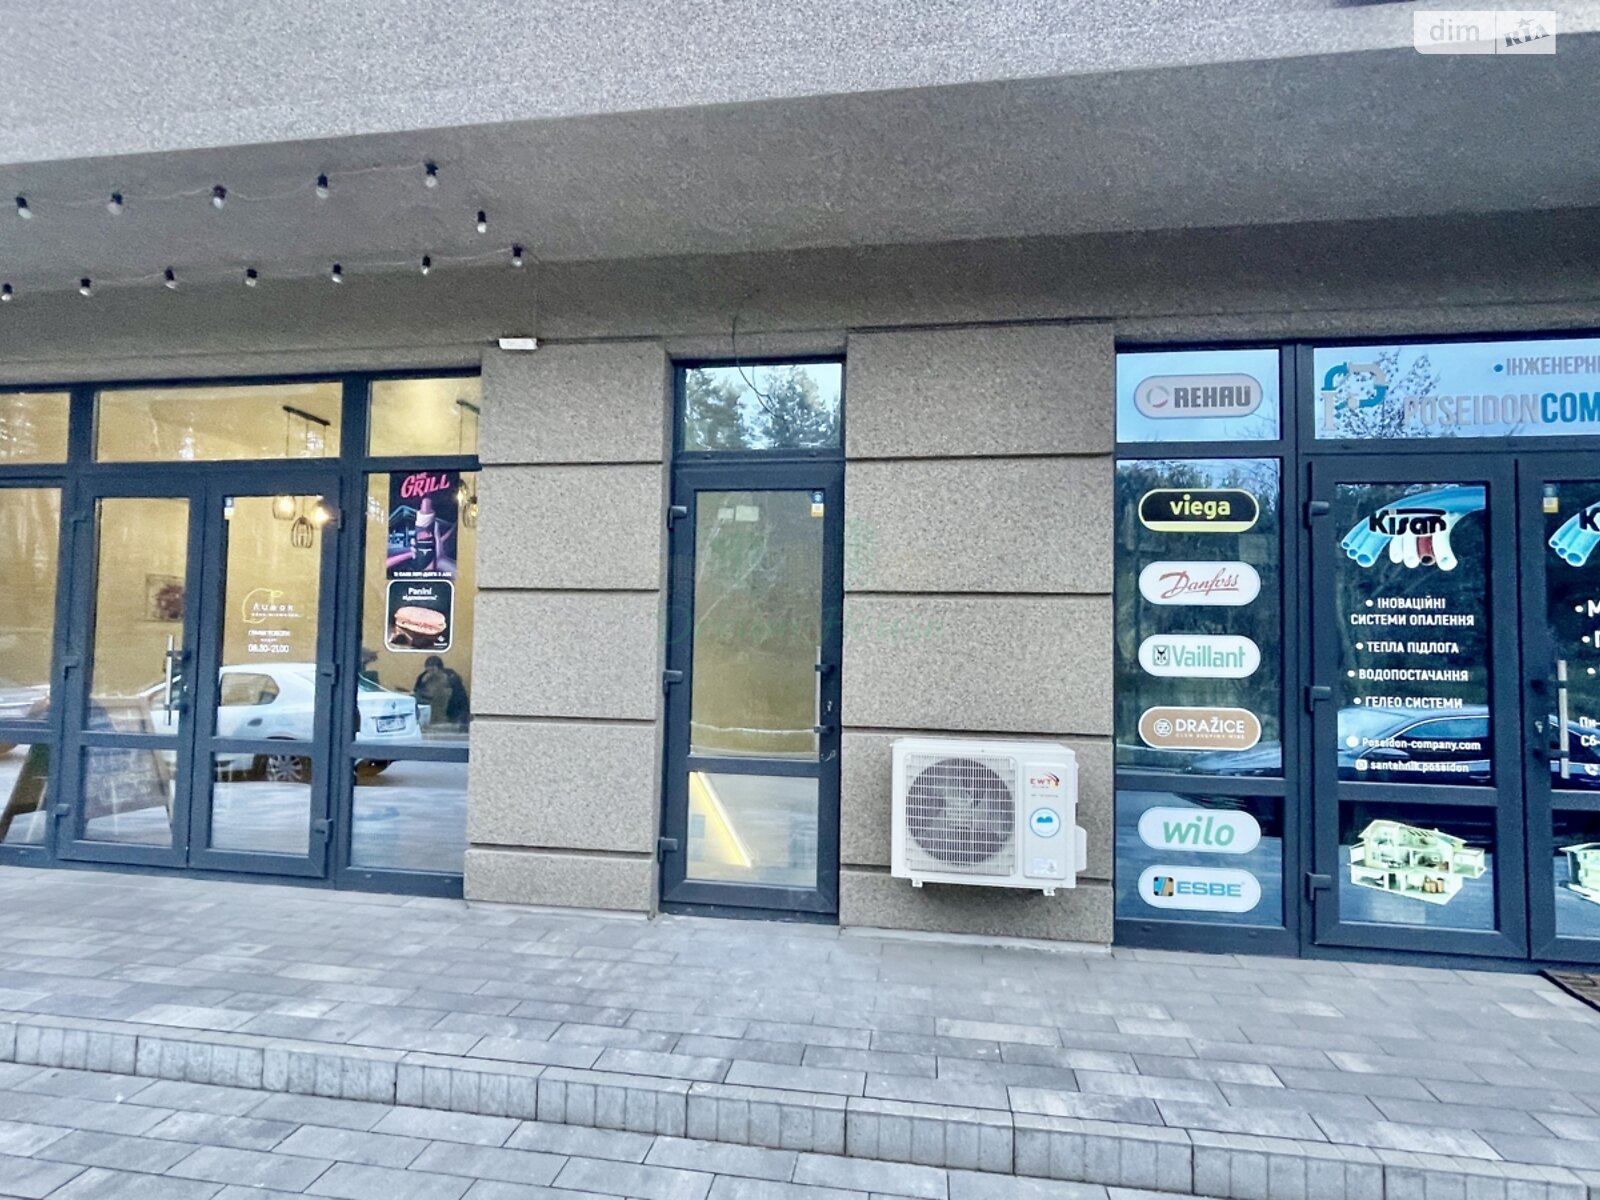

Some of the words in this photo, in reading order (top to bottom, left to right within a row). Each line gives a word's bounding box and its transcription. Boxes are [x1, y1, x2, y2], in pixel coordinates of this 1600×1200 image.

[1173, 385, 1251, 407] REHAU
[401, 474, 450, 497] GRILL
[1169, 493, 1231, 517] viega
[1369, 507, 1447, 536] Kisan
[408, 587, 431, 595] Panini
[1158, 568, 1240, 598] Danfoss
[1377, 596, 1446, 610] ІНОВАЦІЙНІ
[1351, 614, 1407, 625] СИСТЕМИ
[1409, 614, 1474, 626] ОПАЛЕННЯ
[1172, 642, 1246, 669] Vaillant
[1367, 641, 1404, 653] ТЕПЛА
[1407, 642, 1459, 655] ПІДЛОГА
[1358, 669, 1469, 682] ВОДОПОСТАЧАННЯ
[1365, 696, 1401, 708] ГЕЛЕО
[1405, 698, 1463, 709] СИСТЕМИ
[1174, 716, 1245, 734] DRAŽICE
[1362, 737, 1481, 752] Poseidon-company.com
[1162, 815, 1235, 848] wilo
[1176, 881, 1242, 897] ESBE
